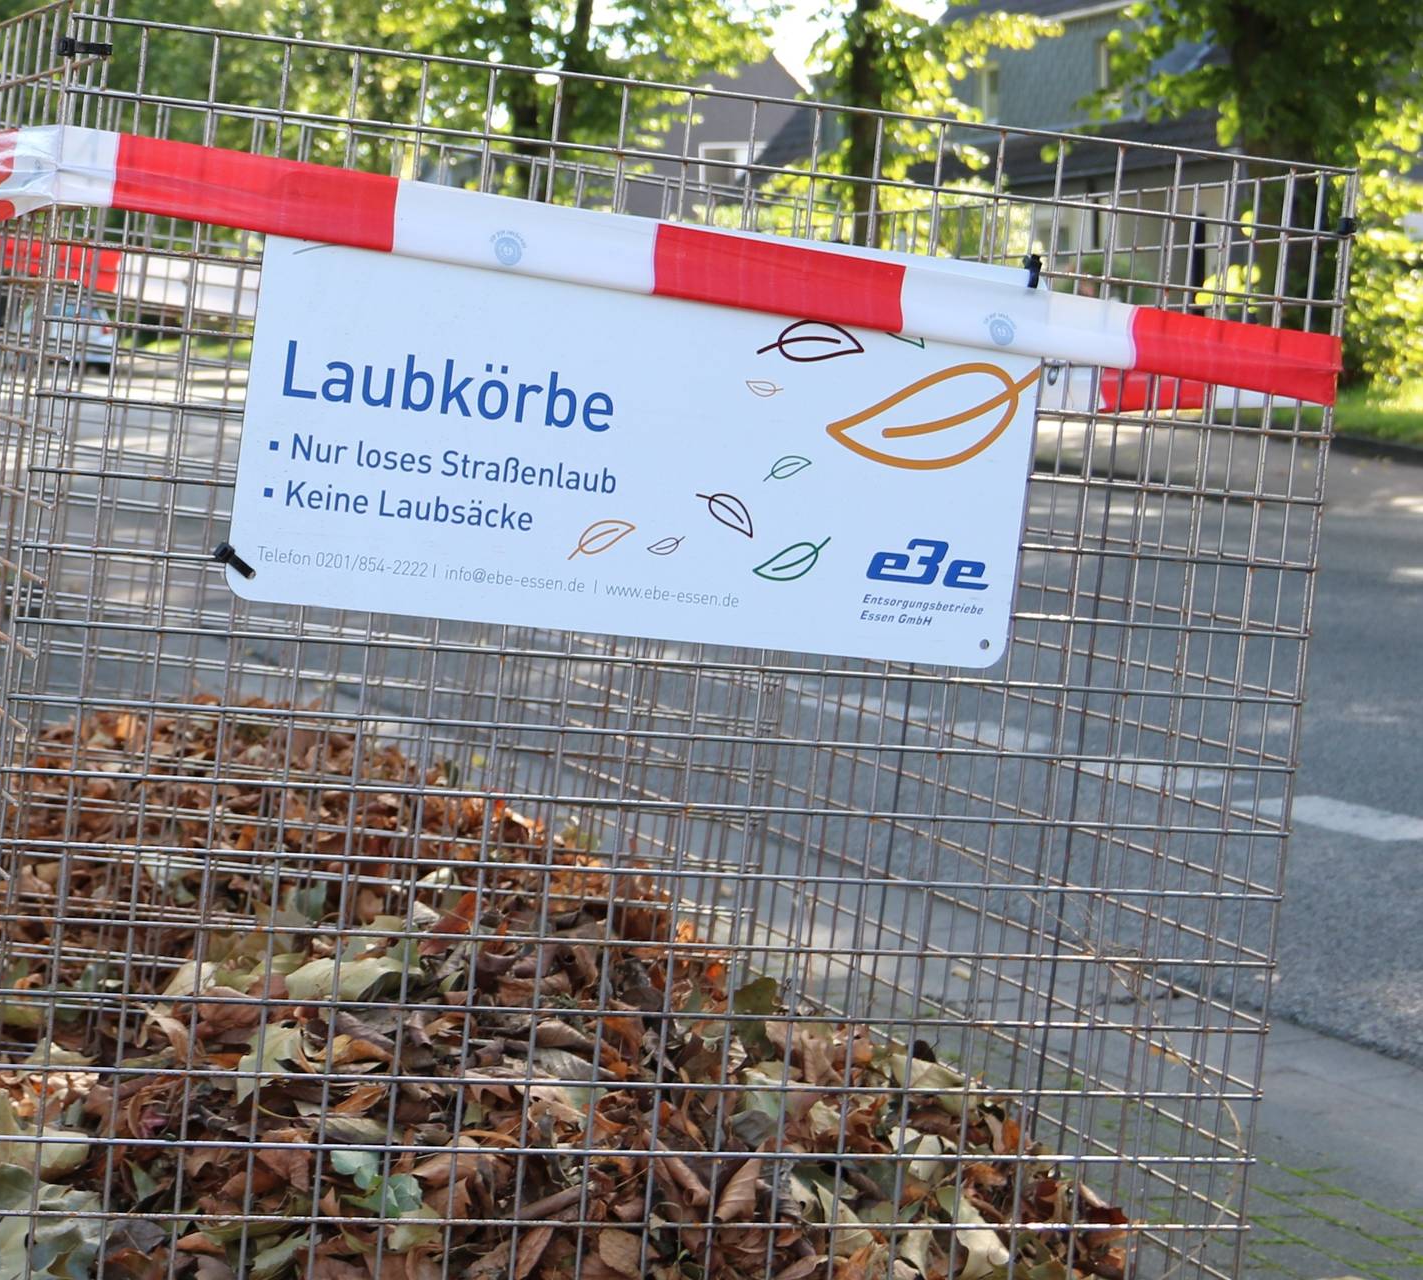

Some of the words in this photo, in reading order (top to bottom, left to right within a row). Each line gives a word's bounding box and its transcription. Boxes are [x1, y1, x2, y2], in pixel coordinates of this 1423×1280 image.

[281, 339, 614, 433] Laubkörbe
[290, 433, 349, 465] Nur
[356, 440, 432, 475] loses
[440, 449, 617, 495] Straßenlaub
[284, 480, 369, 515] Keine
[378, 489, 534, 532] Laubsäcke
[257, 545, 312, 566] Telefon
[315, 551, 429, 578] 0201/854-2222
[444, 564, 585, 593] info@ebe-essen.de
[605, 583, 740, 608] www.ebe-essen.de
[862, 593, 985, 616] Entsorgungsbetriebe
[860, 609, 895, 623] Essen
[897, 613, 933, 627] GmbH
